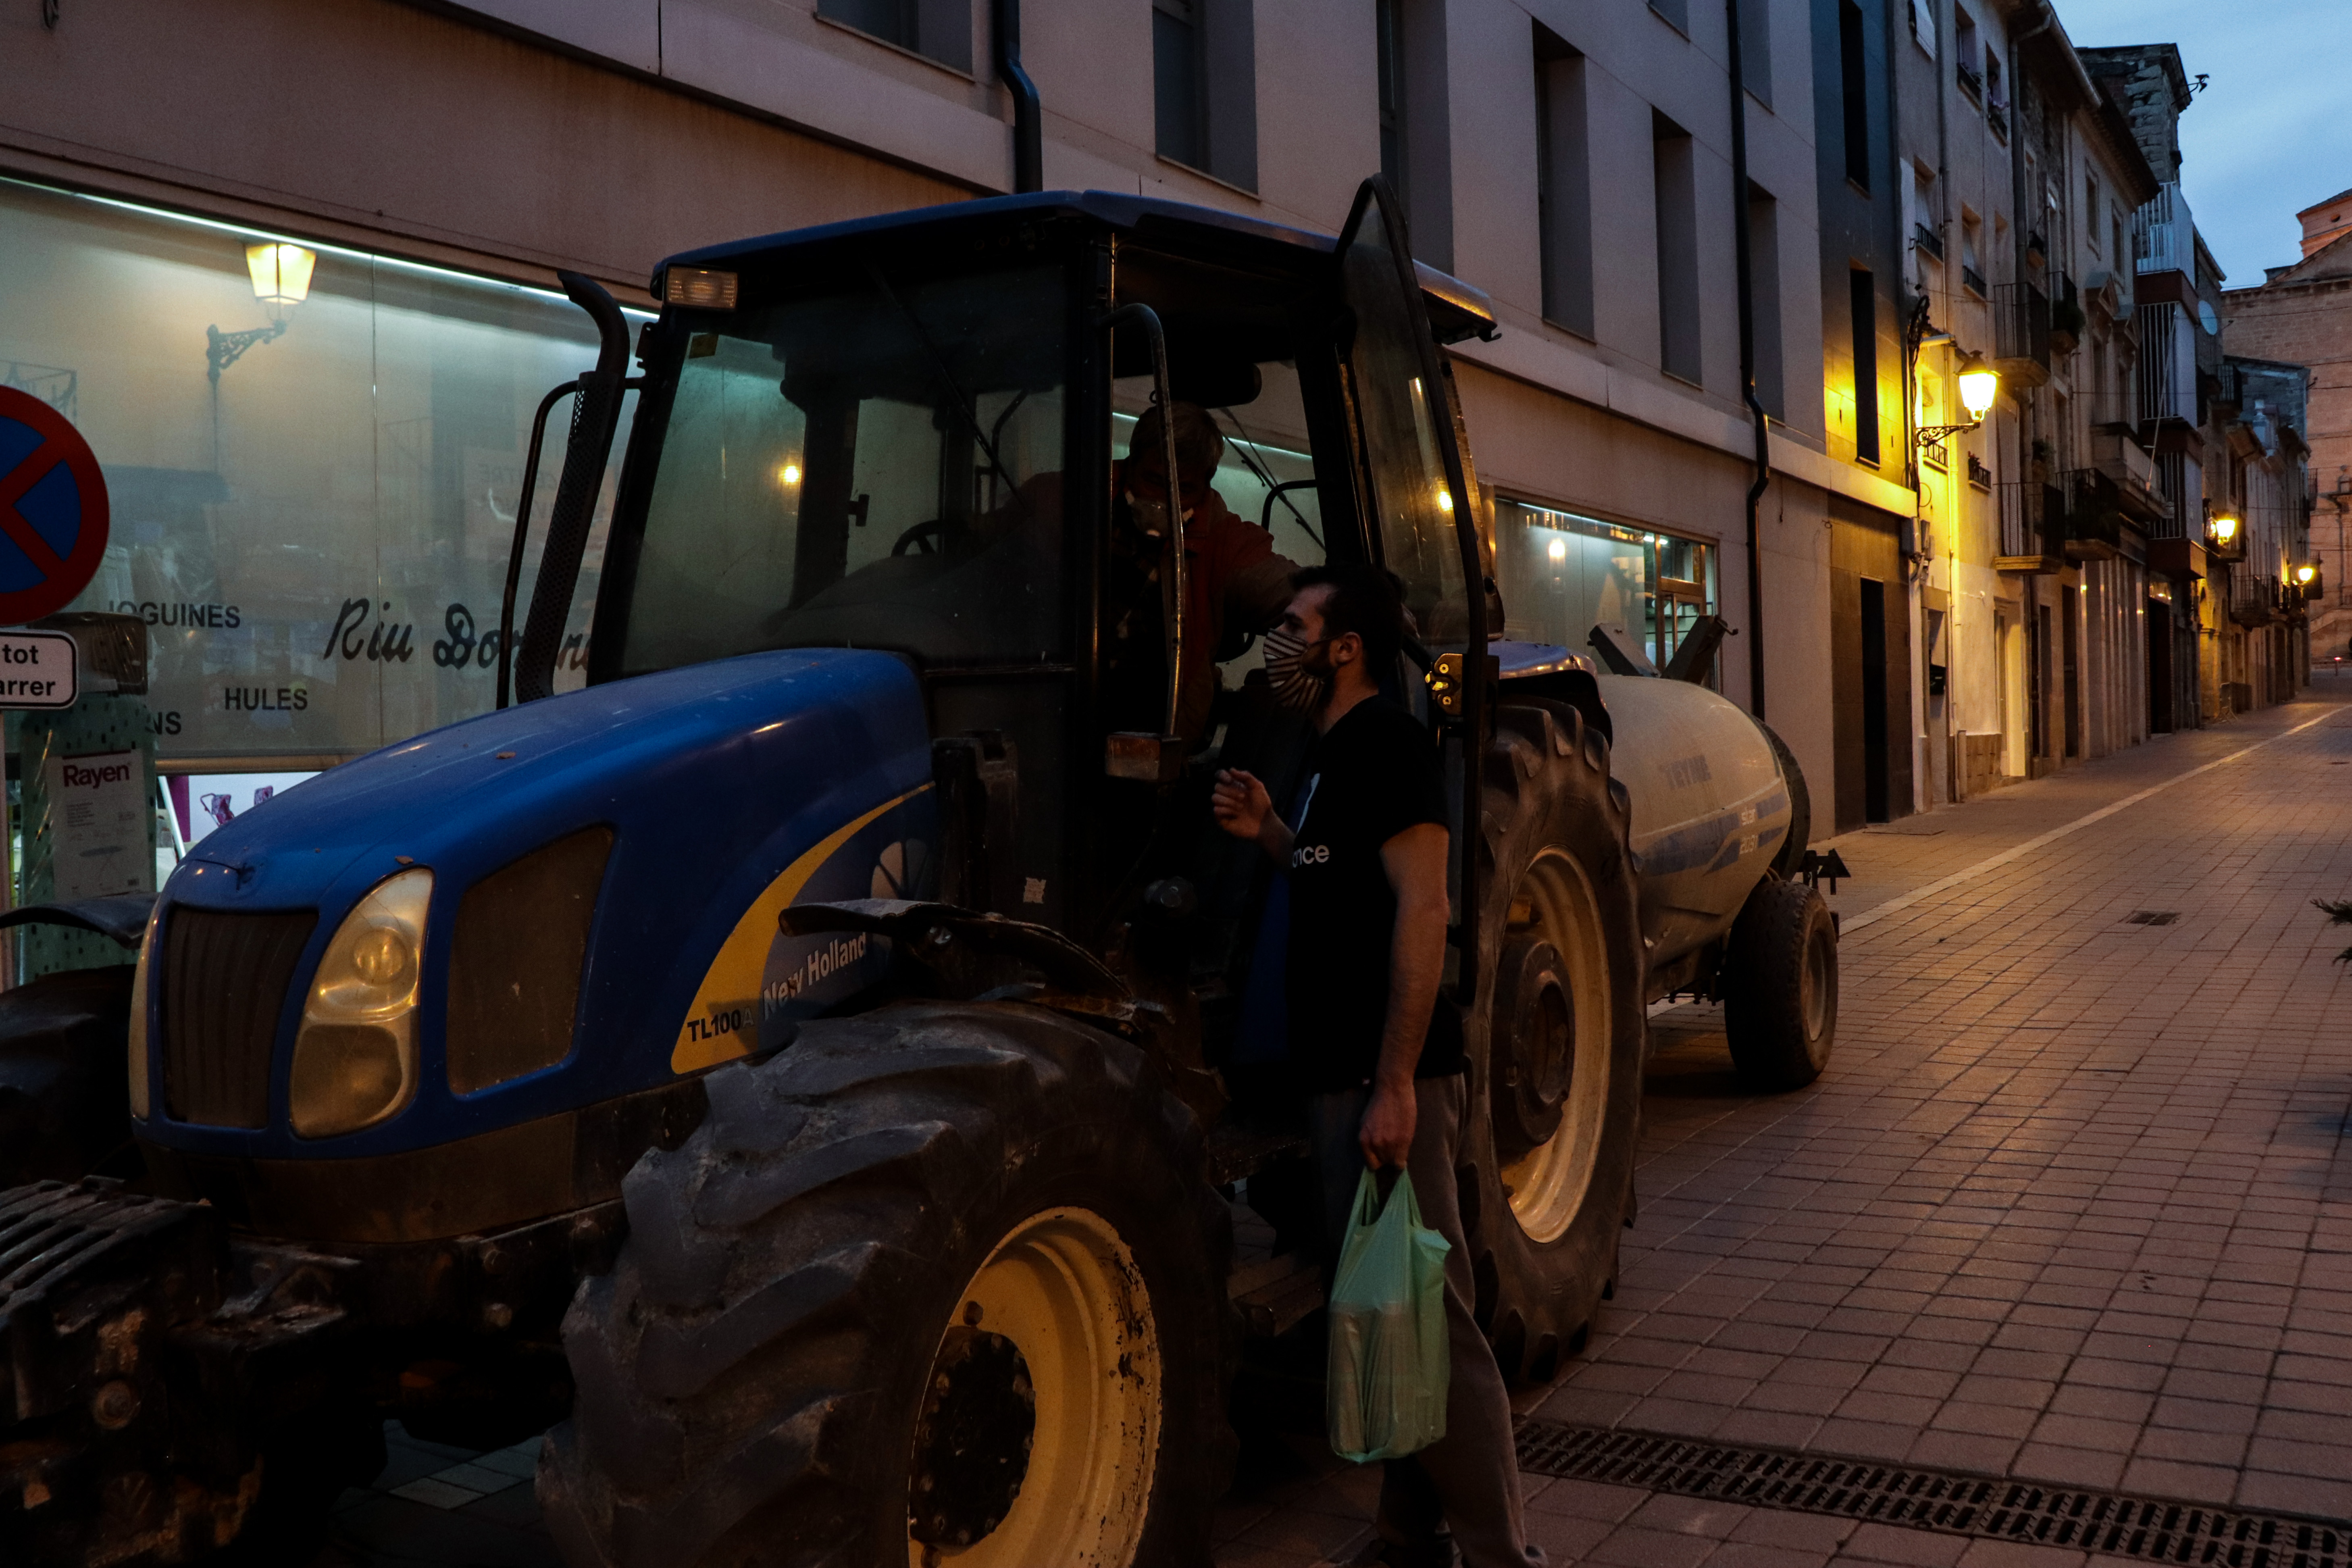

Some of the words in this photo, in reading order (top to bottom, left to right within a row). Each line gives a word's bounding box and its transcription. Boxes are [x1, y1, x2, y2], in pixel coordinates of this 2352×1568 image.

[324, 598, 414, 662] Riu
[2, 644, 38, 664] tot
[225, 688, 308, 711] HULES
[63, 764, 129, 789] Rayen
[763, 967, 803, 1021] New
[808, 931, 866, 986] Holland
